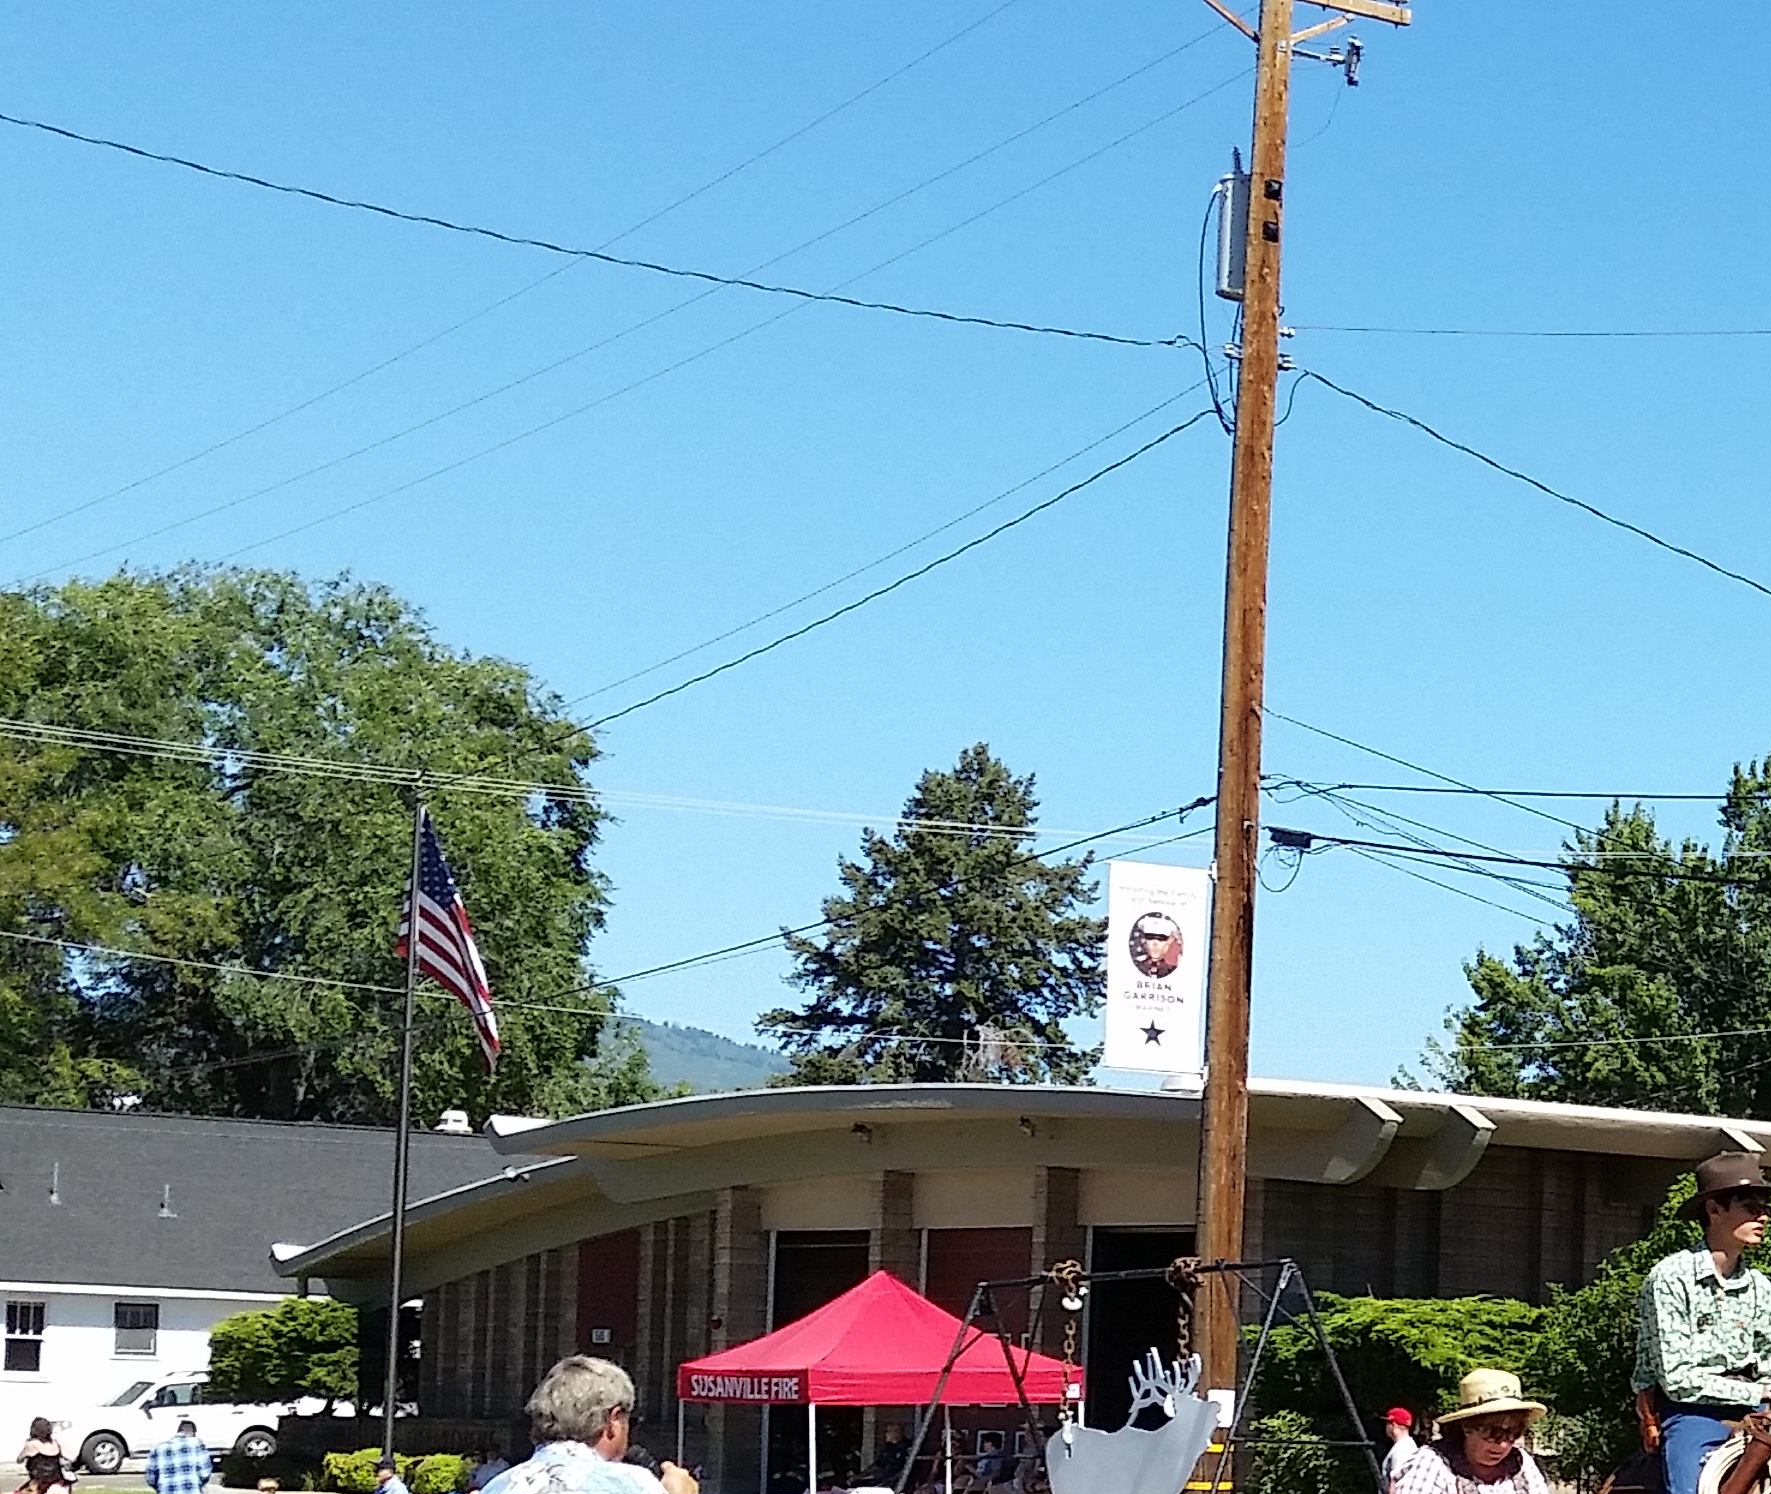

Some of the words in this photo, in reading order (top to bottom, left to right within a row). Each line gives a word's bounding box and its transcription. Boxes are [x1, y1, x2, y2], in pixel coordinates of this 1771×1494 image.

[1136, 980, 1172, 992] BRIAN
[1123, 990, 1184, 1004] GARRISON
[690, 1374, 769, 1400] SUSANVILLE
[770, 1376, 799, 1400] FIRE
